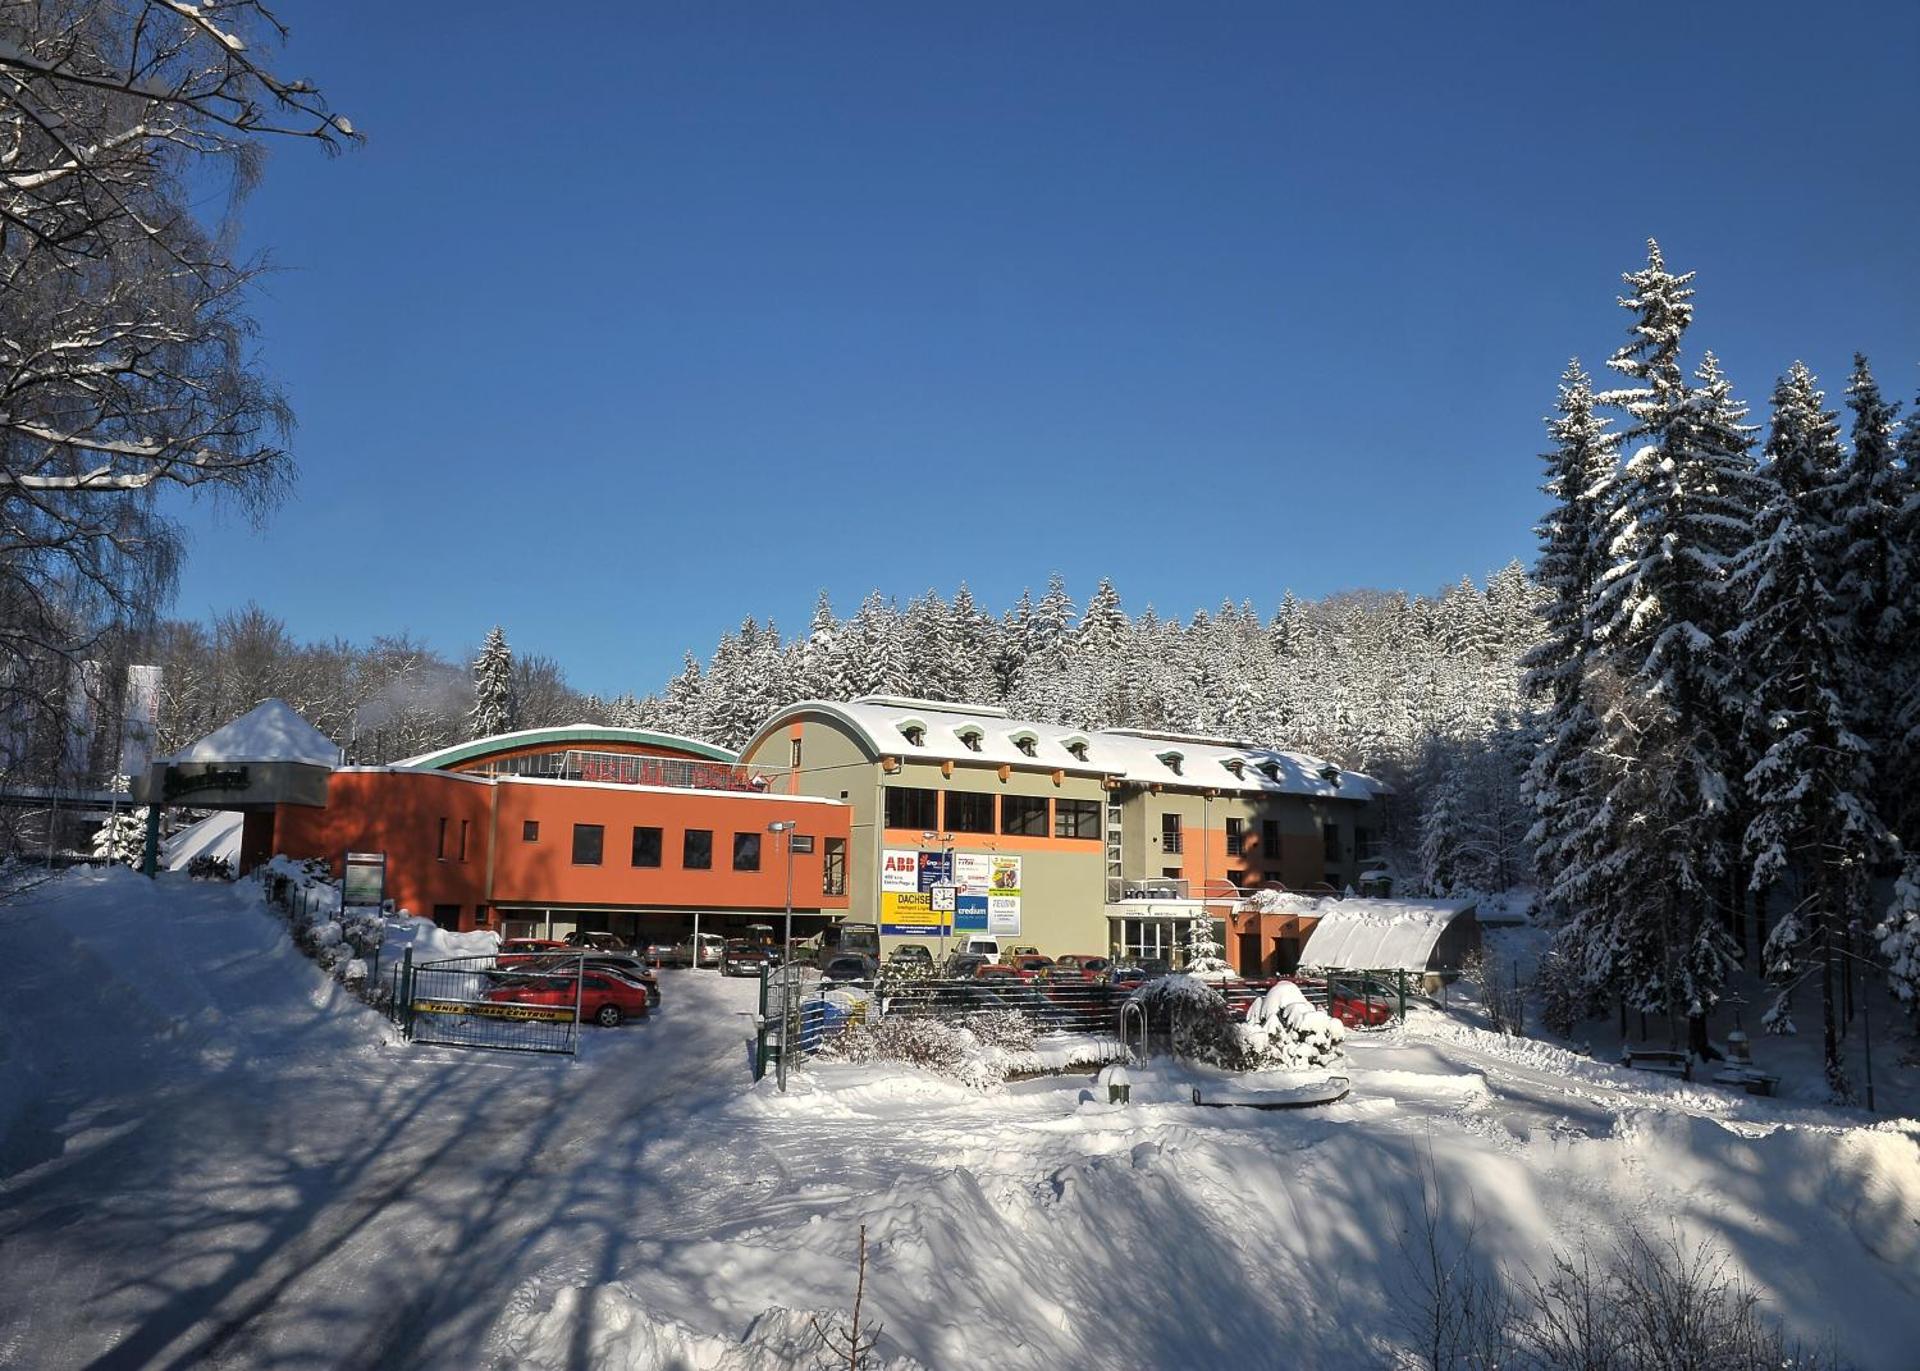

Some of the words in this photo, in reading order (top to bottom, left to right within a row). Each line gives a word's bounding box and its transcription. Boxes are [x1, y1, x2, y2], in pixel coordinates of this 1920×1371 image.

[885, 856, 915, 872] ABB
[898, 894, 931, 905] DACHSE
[958, 904, 986, 914] credium
[506, 1009, 556, 1018] CENTRUM
